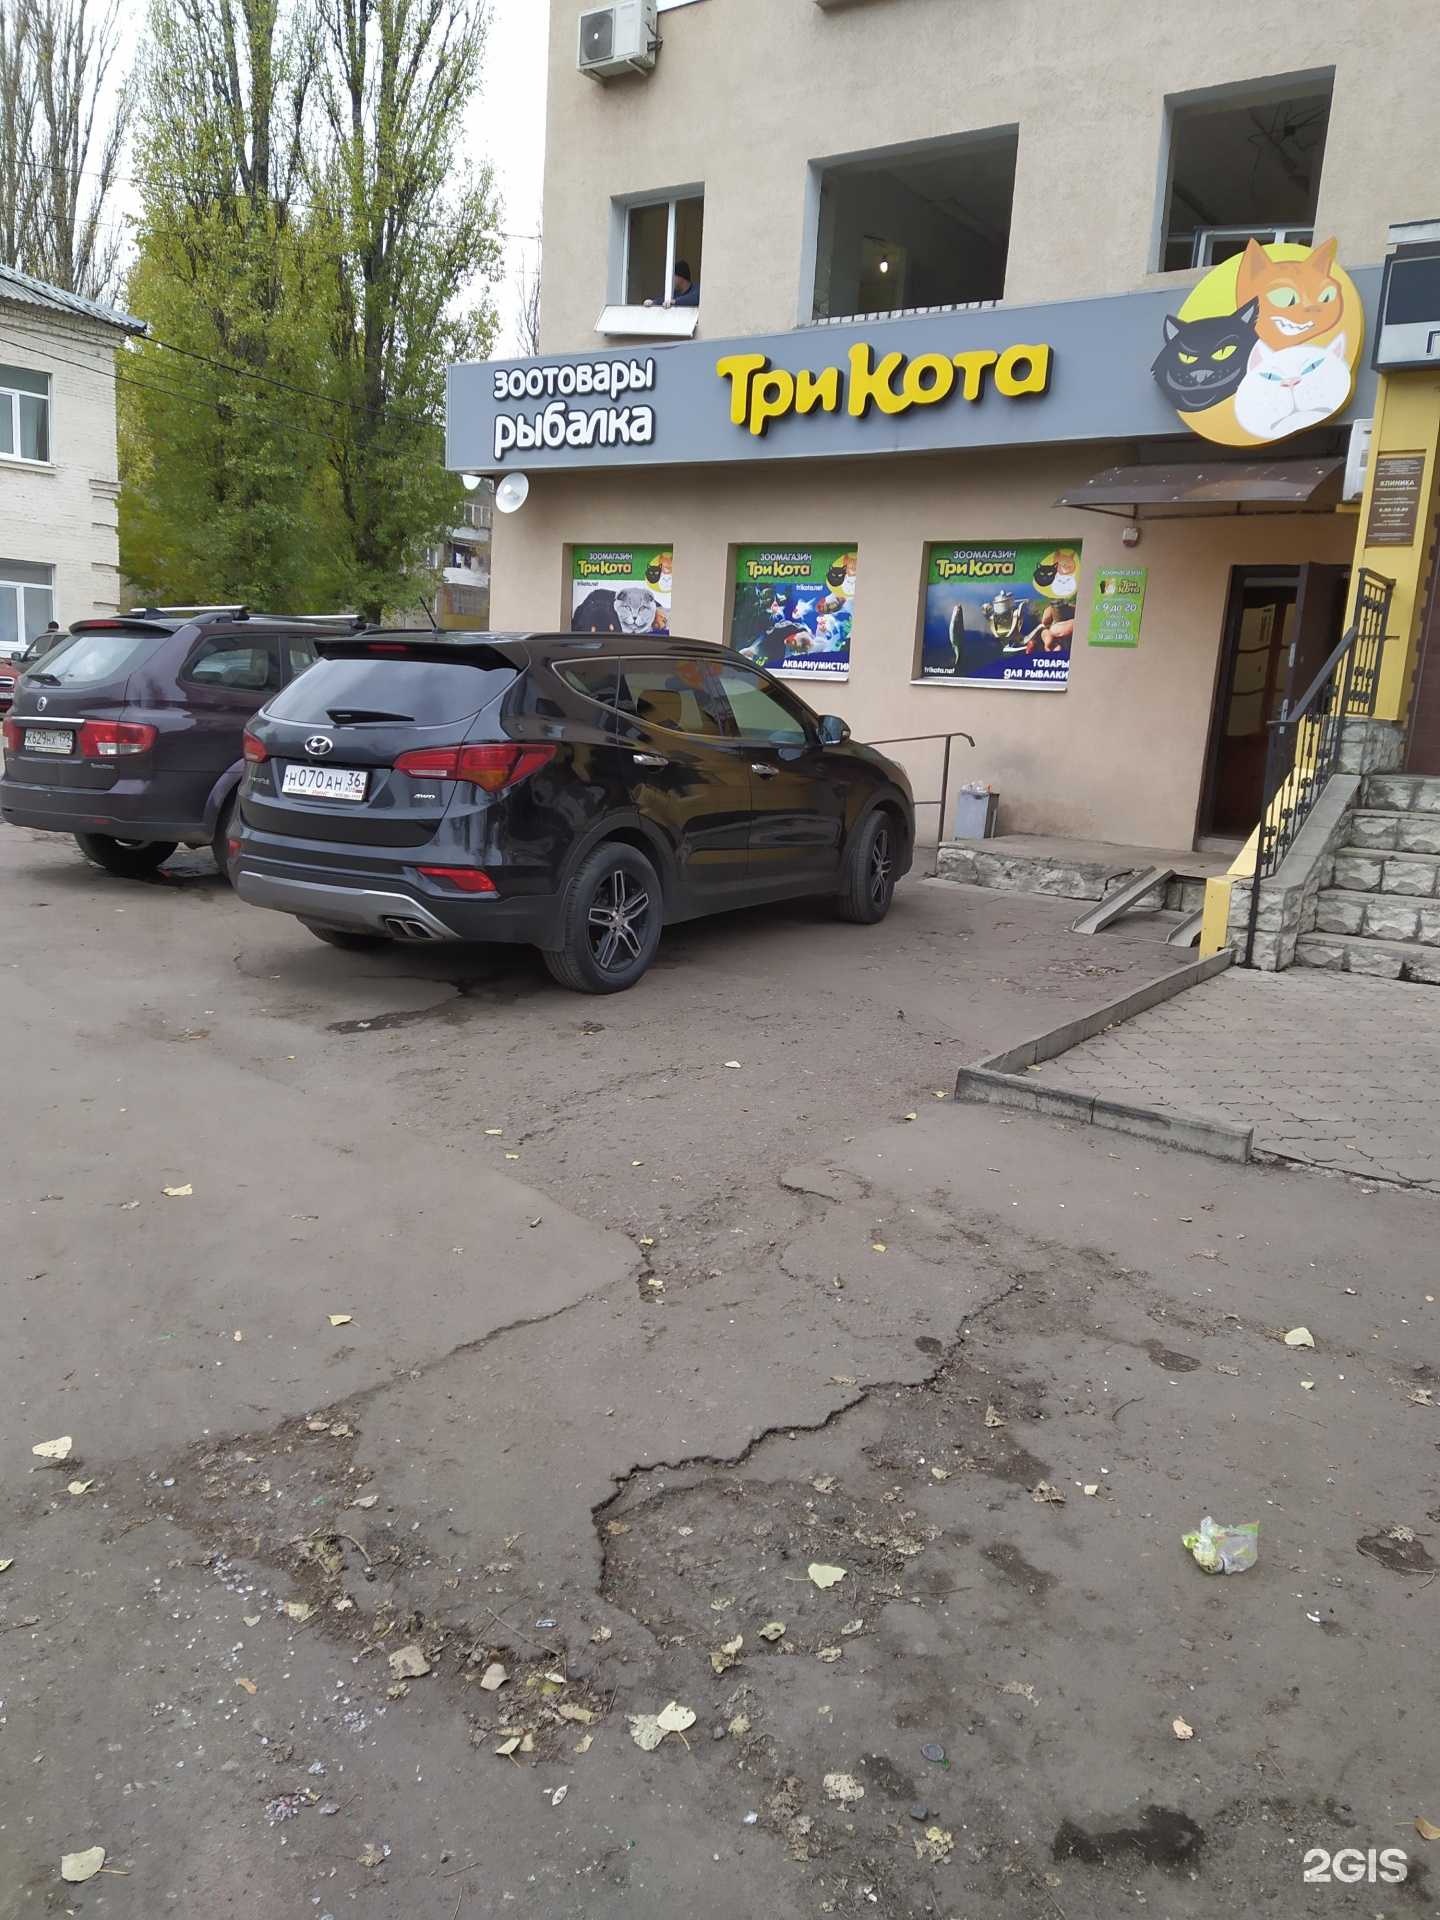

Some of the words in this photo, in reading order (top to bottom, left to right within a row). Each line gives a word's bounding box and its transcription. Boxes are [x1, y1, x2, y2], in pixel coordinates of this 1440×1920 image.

[717, 354, 838, 435] Три
[848, 343, 1050, 415] Кота
[1380, 479, 1415, 487] КЛИНИКА
[760, 553, 812, 561] ЗООМАГАЗИН
[953, 550, 1016, 560] ЗООМАГАЗИН
[578, 560, 600, 576] Три
[600, 560, 632, 575] Кота
[747, 561, 772, 578] Три
[773, 561, 810, 577] Кота
[936, 559, 967, 578] Три
[968, 559, 1014, 576] Кота
[1033, 659, 1070, 668] ТОВАРЫ
[1025, 669, 1069, 680] РЫБАЛКИ
